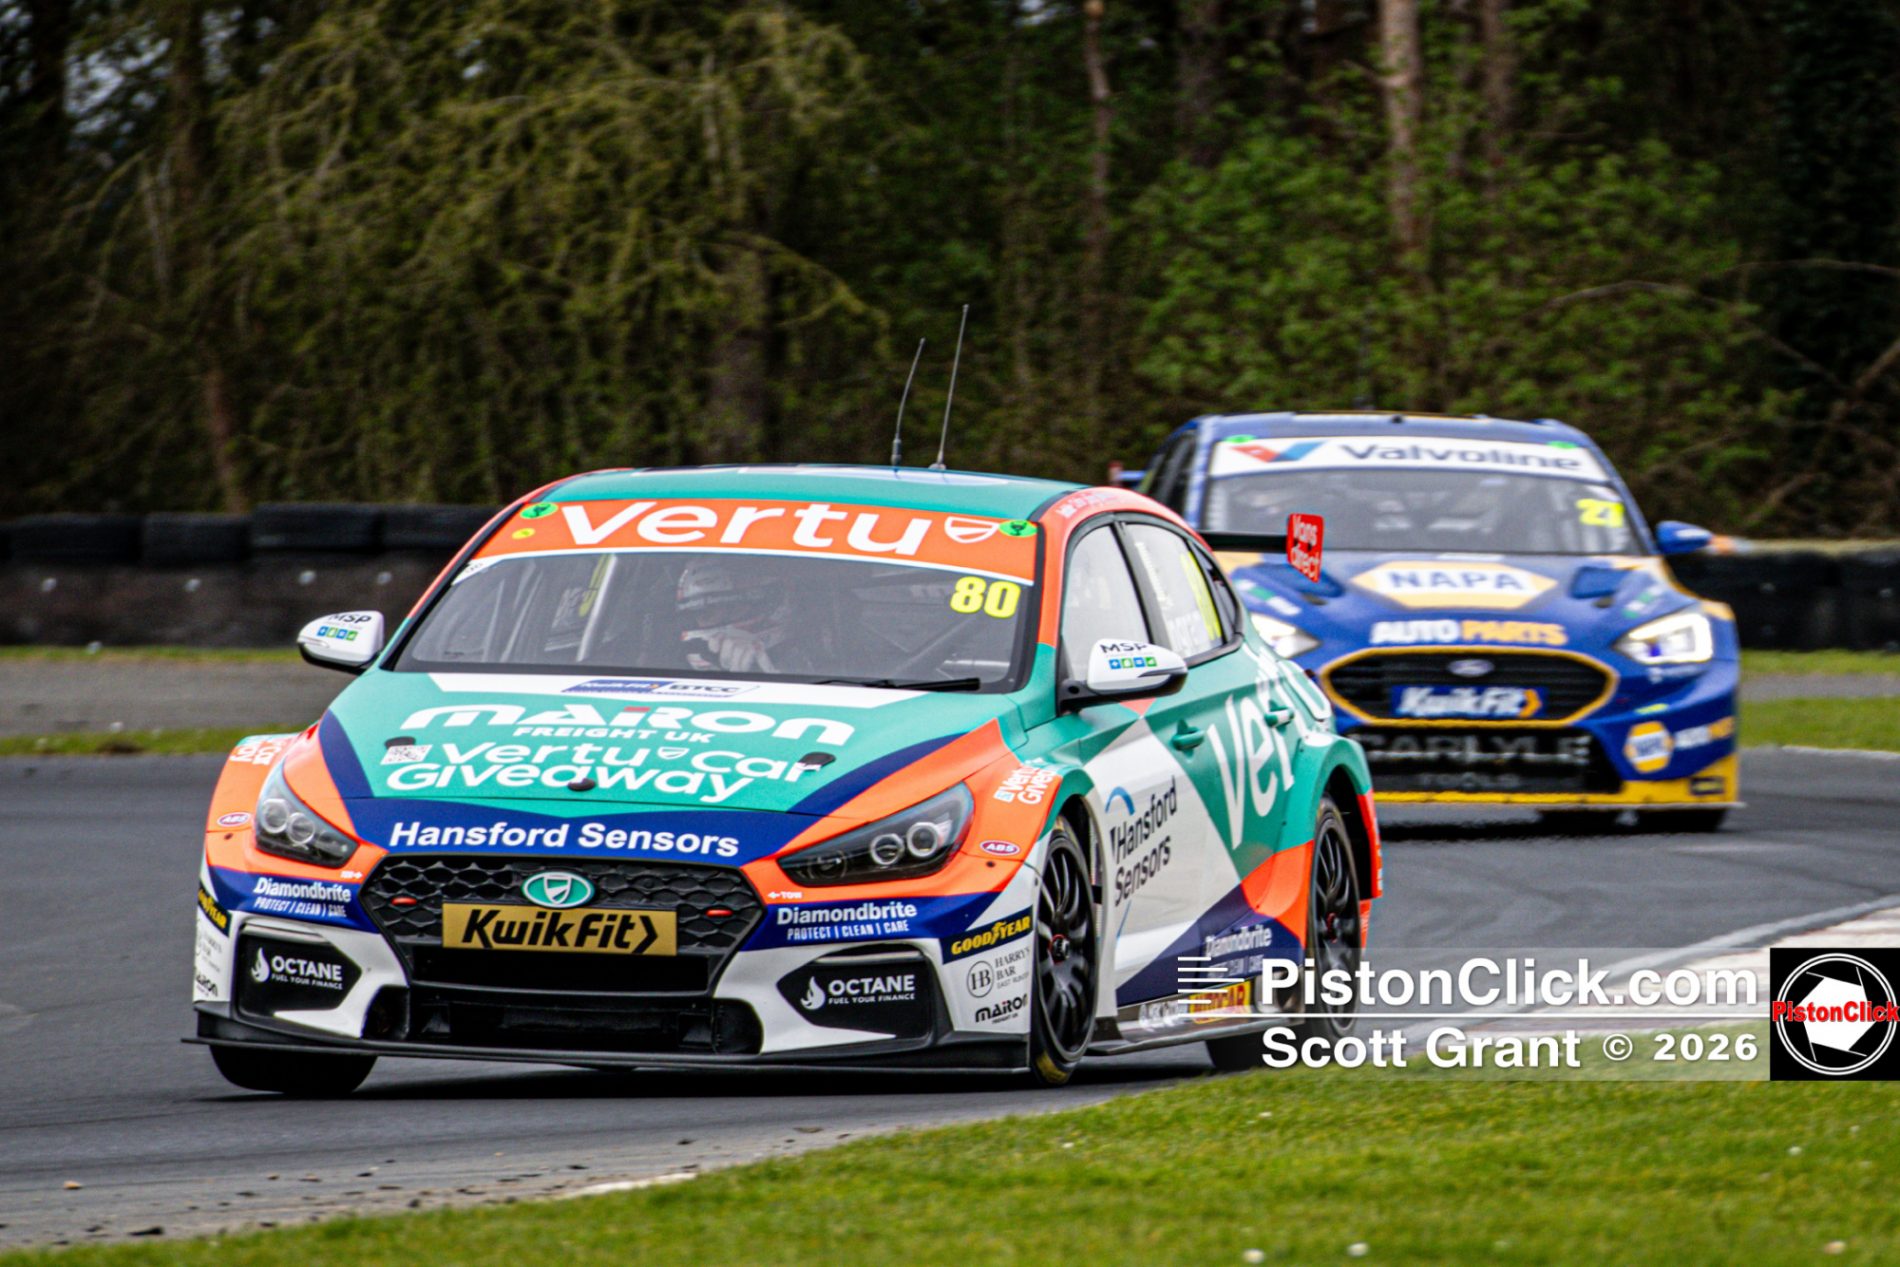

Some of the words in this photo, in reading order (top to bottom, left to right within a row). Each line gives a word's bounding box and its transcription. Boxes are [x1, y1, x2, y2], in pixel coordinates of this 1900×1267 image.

[1340, 443, 1581, 470] Valvoline
[1389, 568, 1526, 590] NAPA
[949, 575, 1022, 619] 80
[512, 727, 656, 742] FREIGHT
[664, 731, 716, 744] UK
[1115, 775, 1177, 865] Hansford
[389, 821, 569, 848] Hansford
[578, 823, 740, 858] Sensors
[986, 843, 1016, 854] ABS
[1115, 835, 1172, 907] Sensors
[253, 877, 352, 902] Diamondbrite
[776, 902, 918, 925] Diamondbrite
[787, 925, 832, 940] PROTECT
[842, 923, 874, 938] CLEAN
[883, 919, 910, 933] CARE
[951, 915, 1031, 955] GOODYEAR
[271, 955, 344, 982] OCTANE
[290, 975, 310, 986] YOUR
[312, 979, 343, 990] FINANCE
[828, 974, 916, 996] OCTANE
[828, 995, 850, 1005] FUEL
[852, 994, 876, 1004] YOUR
[878, 993, 916, 1002] FINANCE
